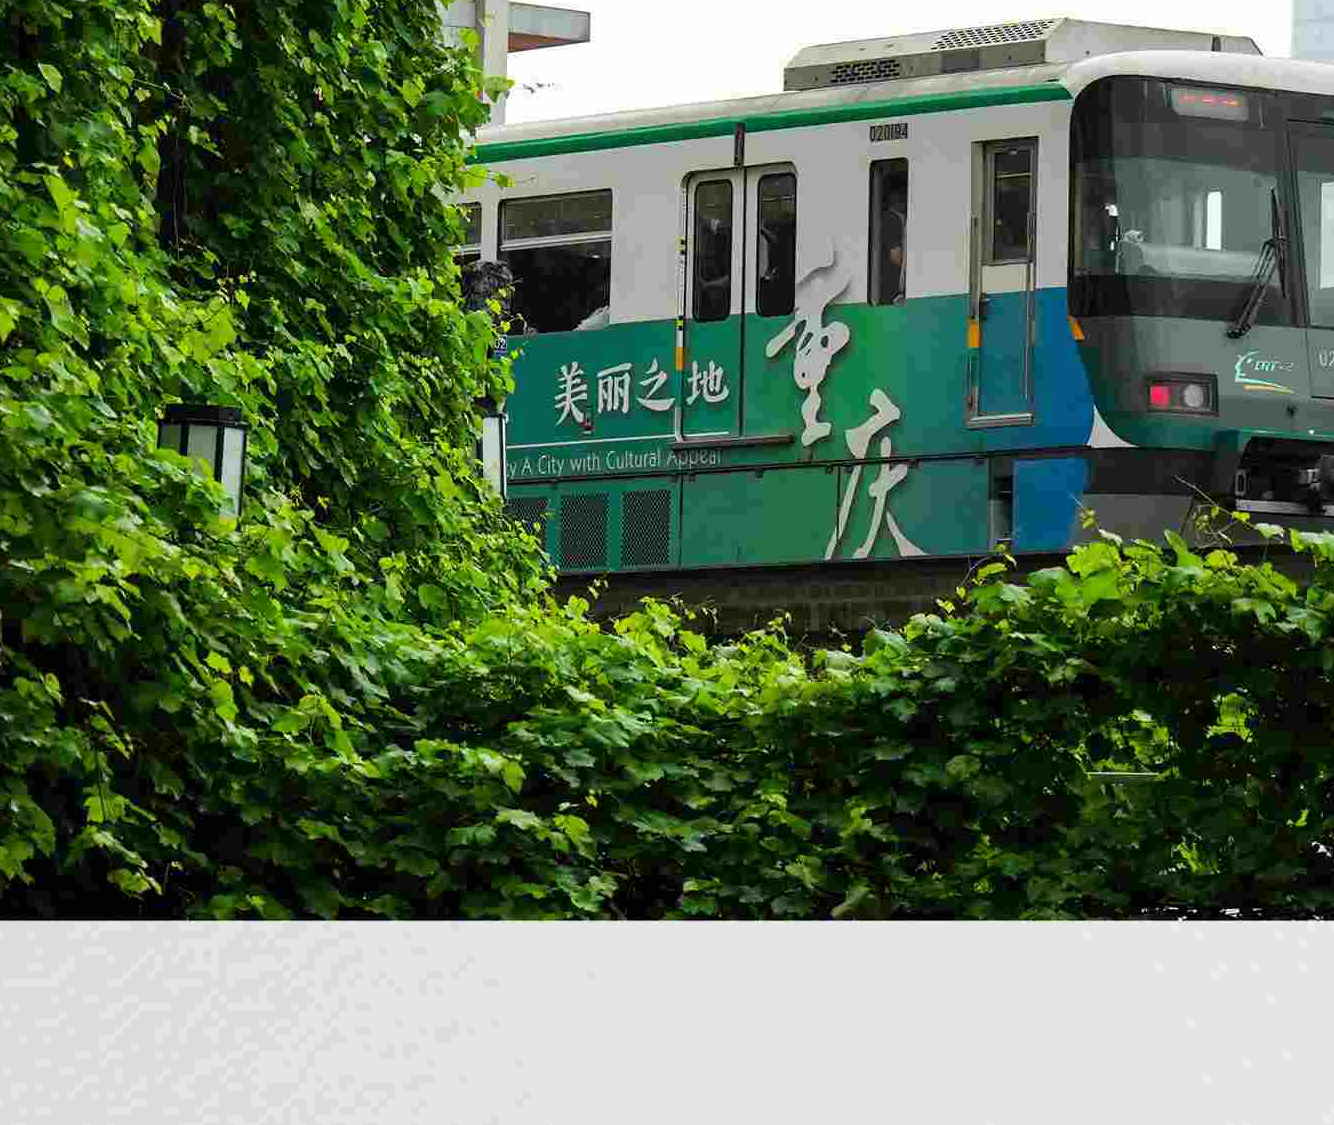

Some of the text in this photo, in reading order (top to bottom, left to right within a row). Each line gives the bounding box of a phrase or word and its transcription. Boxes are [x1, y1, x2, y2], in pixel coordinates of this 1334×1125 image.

[554, 356, 730, 426] 美丽之地
[765, 241, 931, 562] 重庆
[521, 458, 533, 475] A
[537, 454, 565, 476] City
[570, 453, 601, 472] with
[605, 449, 660, 470] Cultural
[666, 449, 721, 470] Appeal
